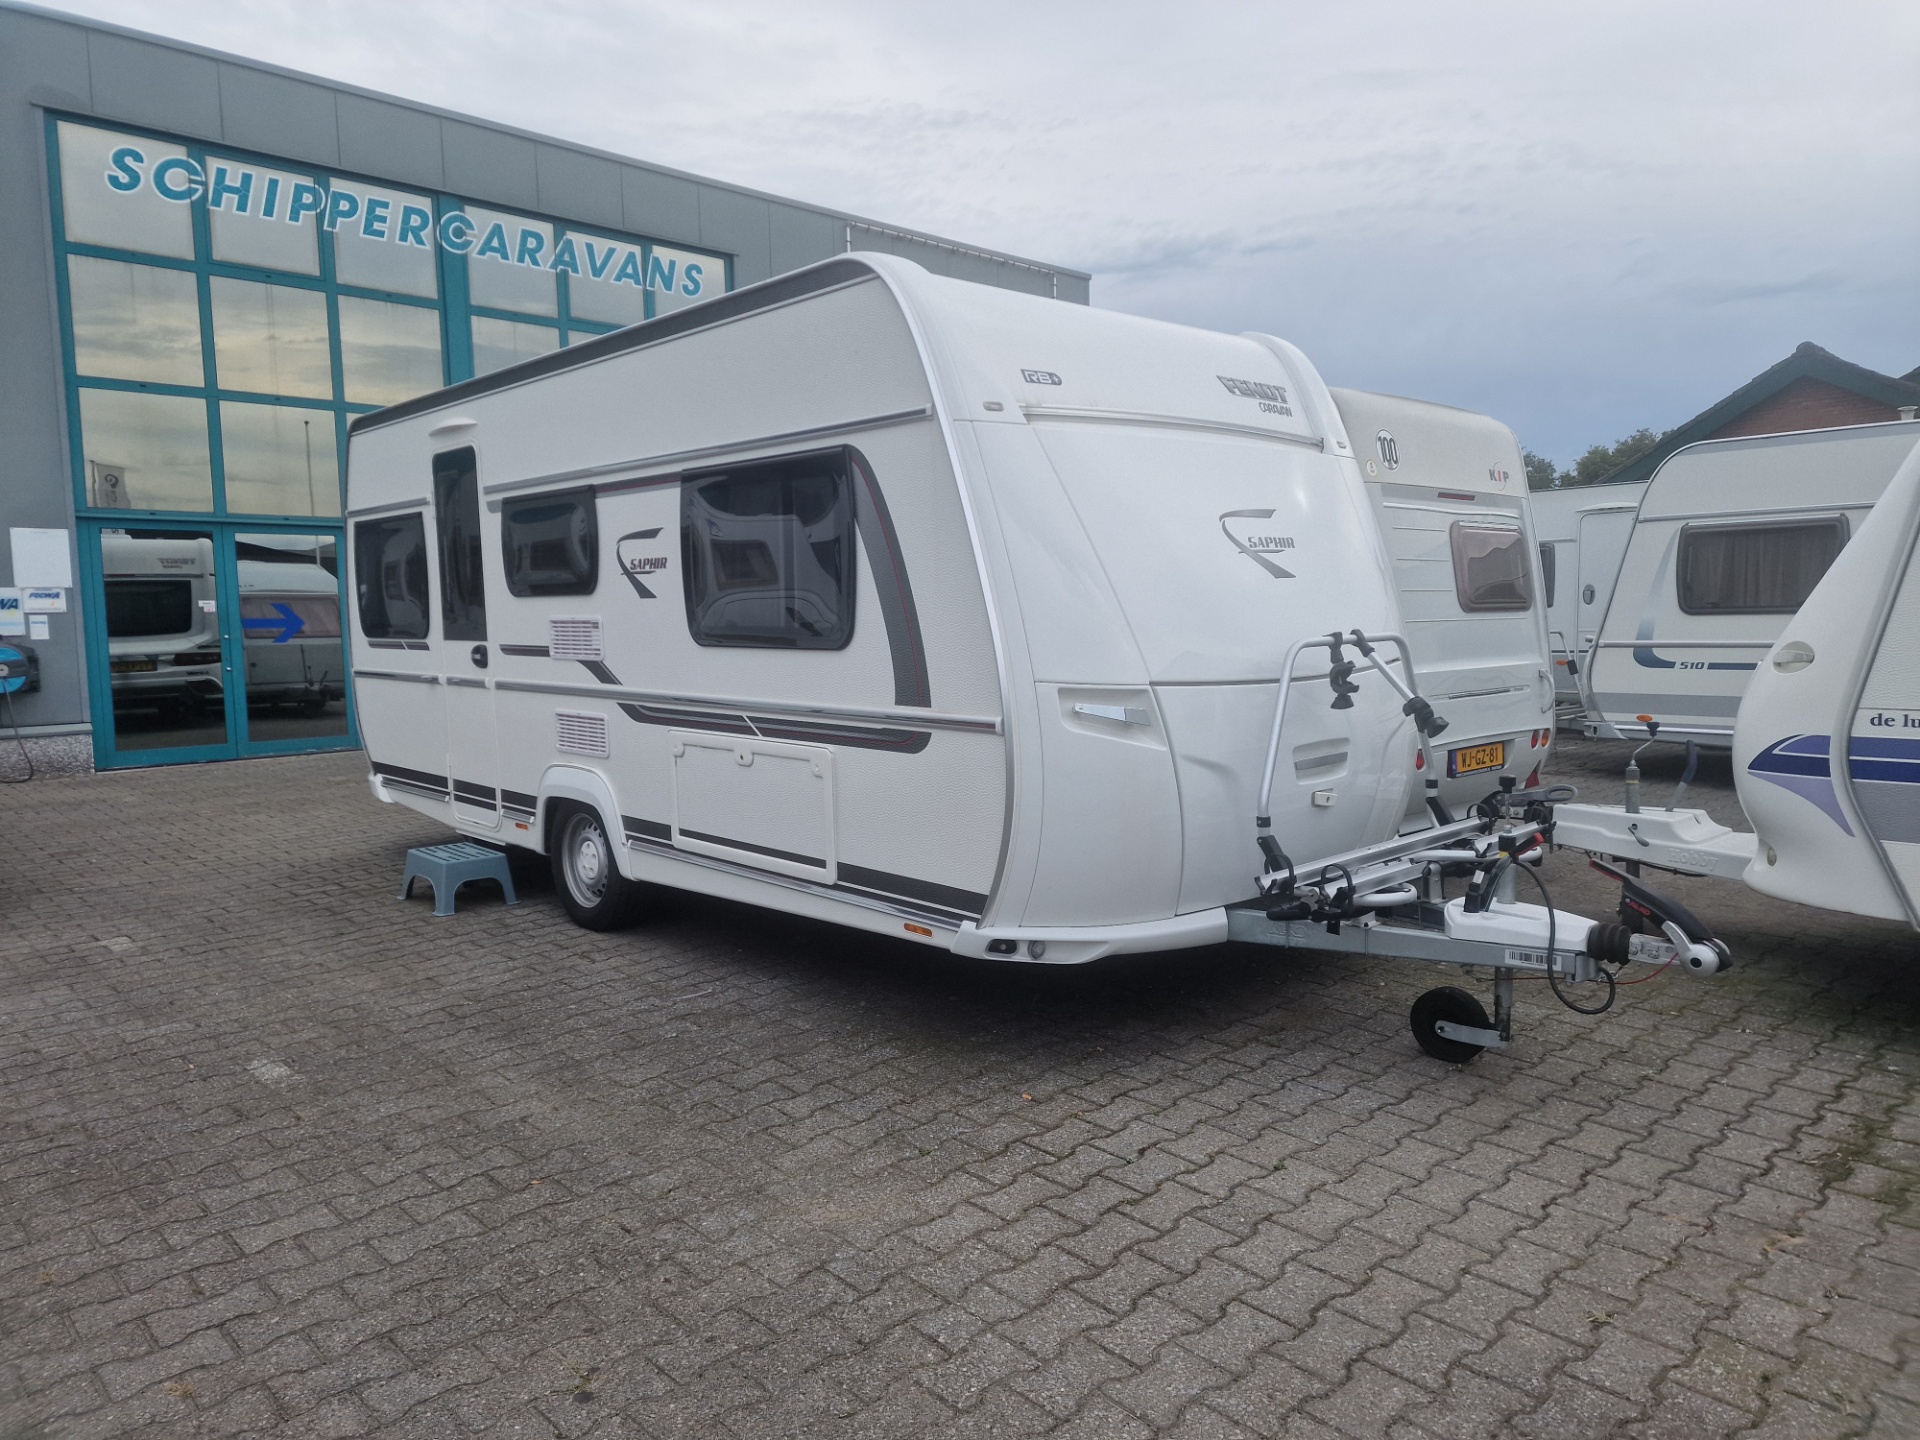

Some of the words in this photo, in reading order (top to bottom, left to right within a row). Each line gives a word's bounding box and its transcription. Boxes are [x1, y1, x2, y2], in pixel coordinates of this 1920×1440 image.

[1216, 375, 1288, 403] FENDT
[1259, 401, 1293, 417] CARAVAN
[1378, 435, 1398, 464] 100
[1488, 468, 1509, 482] KIP
[1247, 536, 1296, 549] SAPHIR
[629, 557, 668, 570] SAPHIR
[1679, 661, 1705, 670] 510
[1870, 712, 1896, 727] de
[1461, 746, 1499, 768] WJ-GZ-81
